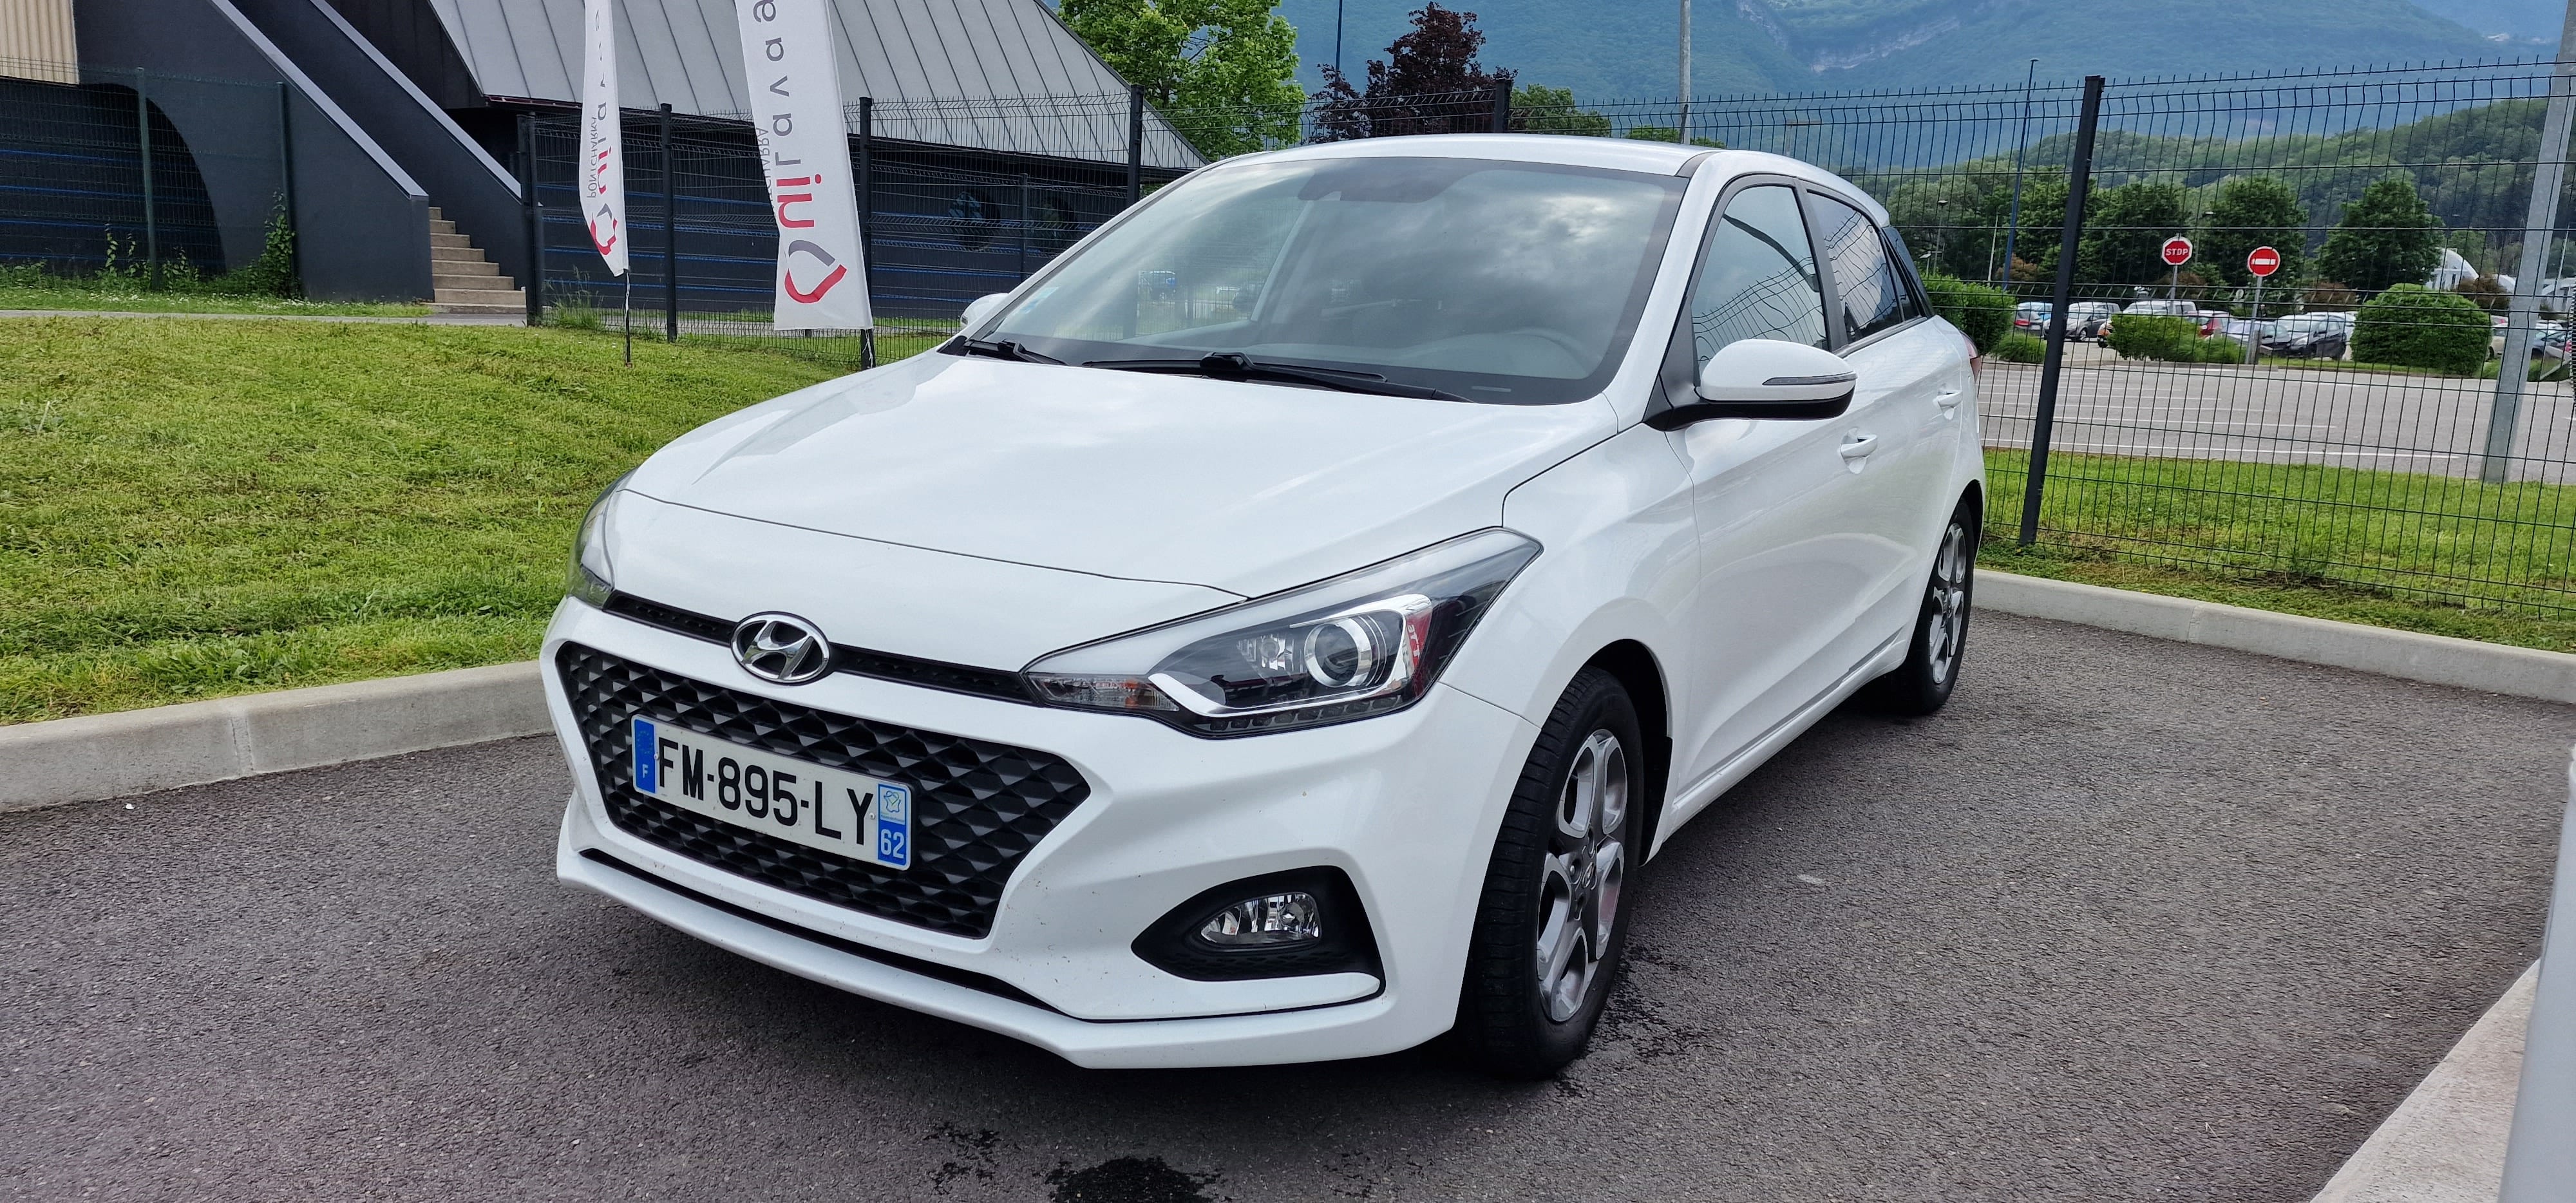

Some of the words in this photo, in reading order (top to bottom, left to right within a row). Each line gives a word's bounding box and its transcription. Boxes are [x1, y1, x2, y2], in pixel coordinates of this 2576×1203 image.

[642, 763, 649, 779] F
[658, 737, 874, 846] FM-895-LY
[880, 828, 905, 859] 62
